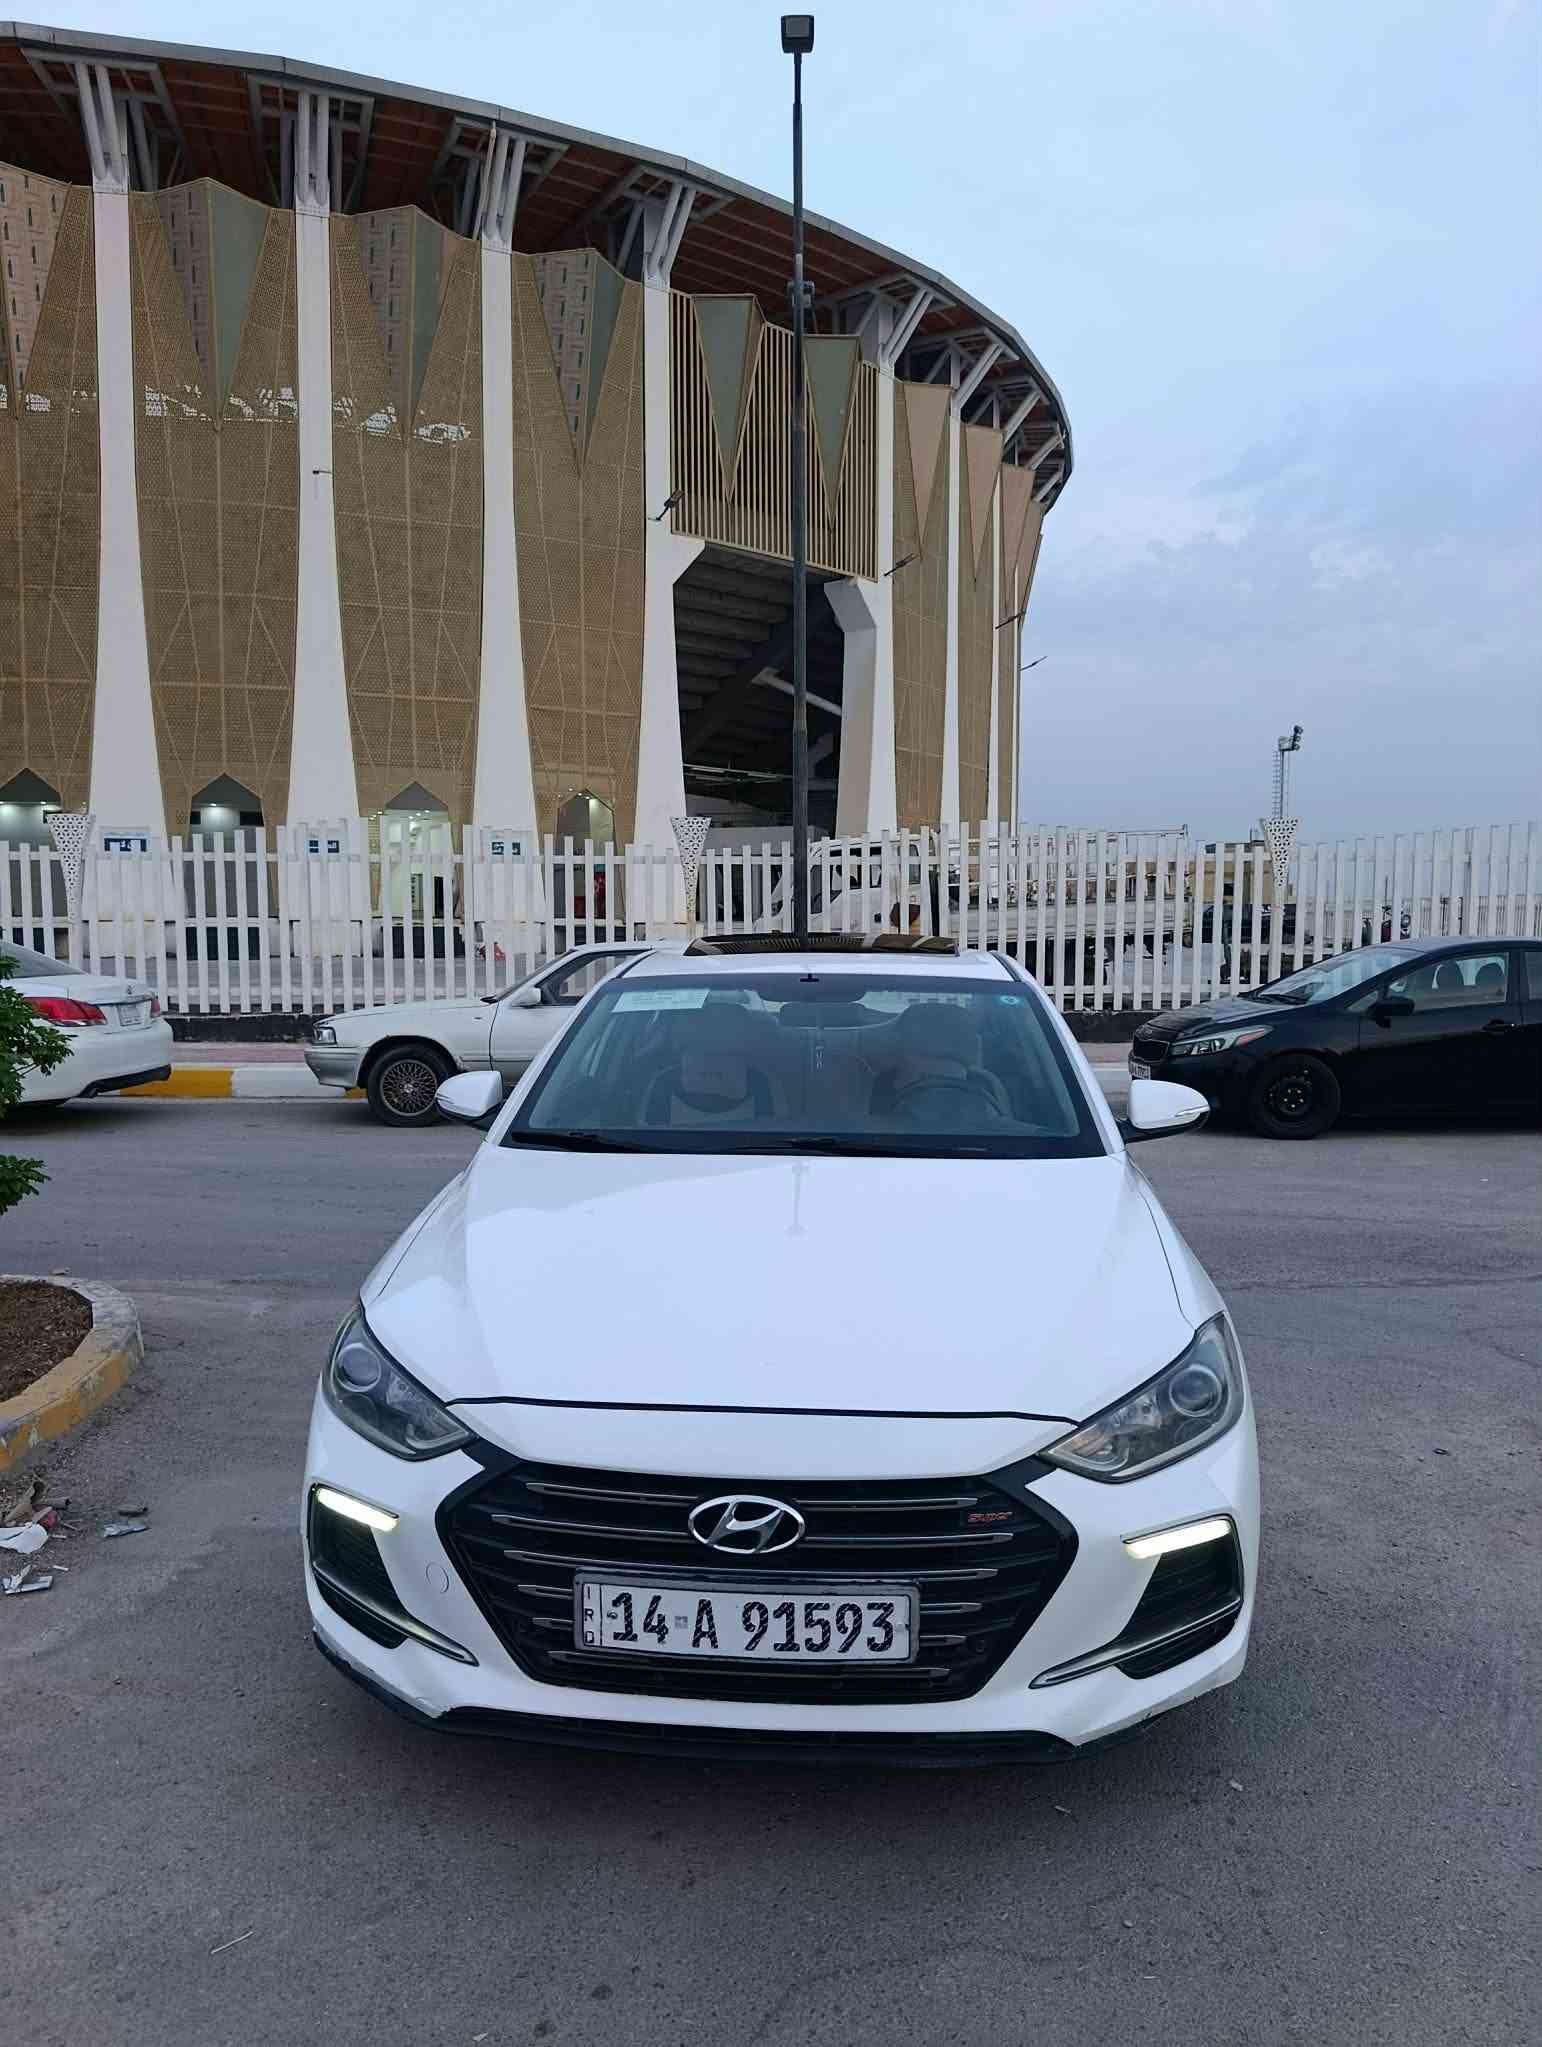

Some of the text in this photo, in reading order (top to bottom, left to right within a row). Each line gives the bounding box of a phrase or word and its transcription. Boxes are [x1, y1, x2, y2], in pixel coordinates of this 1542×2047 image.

[612, 1592, 895, 1652] 14 A 91593
